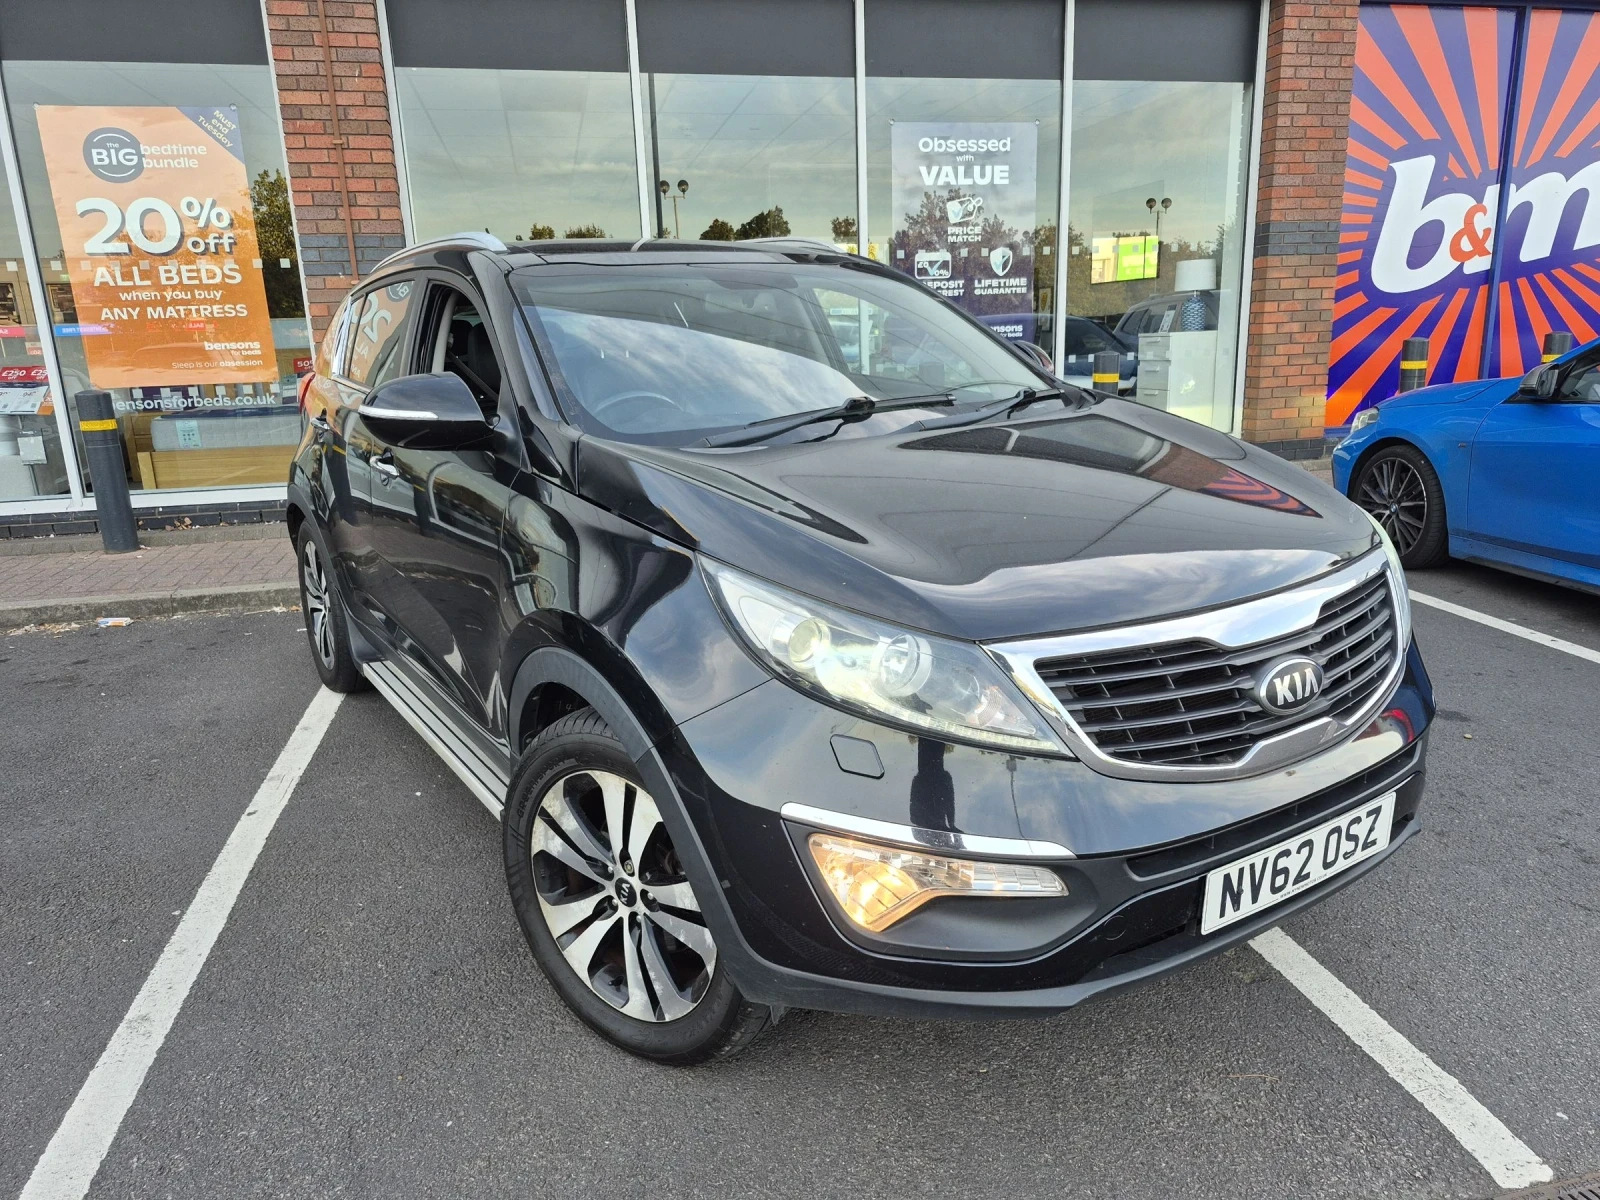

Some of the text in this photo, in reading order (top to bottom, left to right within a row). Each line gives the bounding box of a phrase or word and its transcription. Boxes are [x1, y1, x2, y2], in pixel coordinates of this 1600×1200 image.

[211, 118, 229, 134] end
[214, 110, 237, 130] Must
[198, 115, 234, 147] Tuesday
[140, 143, 207, 155] bedtime
[918, 137, 1011, 152] Obsessed
[91, 148, 139, 166] BIG
[142, 157, 199, 168] bundle
[956, 154, 974, 162] with
[918, 165, 1010, 186] VALUE
[947, 226, 982, 235] PRICE
[186, 233, 235, 254] off
[947, 235, 982, 243] MATCH
[93, 264, 242, 287] ALL BEDS
[974, 277, 1027, 288] LIFETIME
[922, 279, 965, 290] EPOSIT
[973, 287, 1027, 295] GUARANTEE
[119, 288, 223, 302] when you buy
[941, 289, 965, 297] REST
[100, 303, 248, 321] ANY MATTRESS
[203, 340, 261, 351] bensons
[171, 361, 195, 370] Sleep
[219, 359, 263, 367] obsession
[1, 369, 27, 377] £250
[113, 393, 276, 412] ensonsforbeds.co.uk
[1272, 667, 1319, 706] KIA
[1219, 804, 1383, 919] NV62 OSZ
[619, 882, 631, 905] KIA
